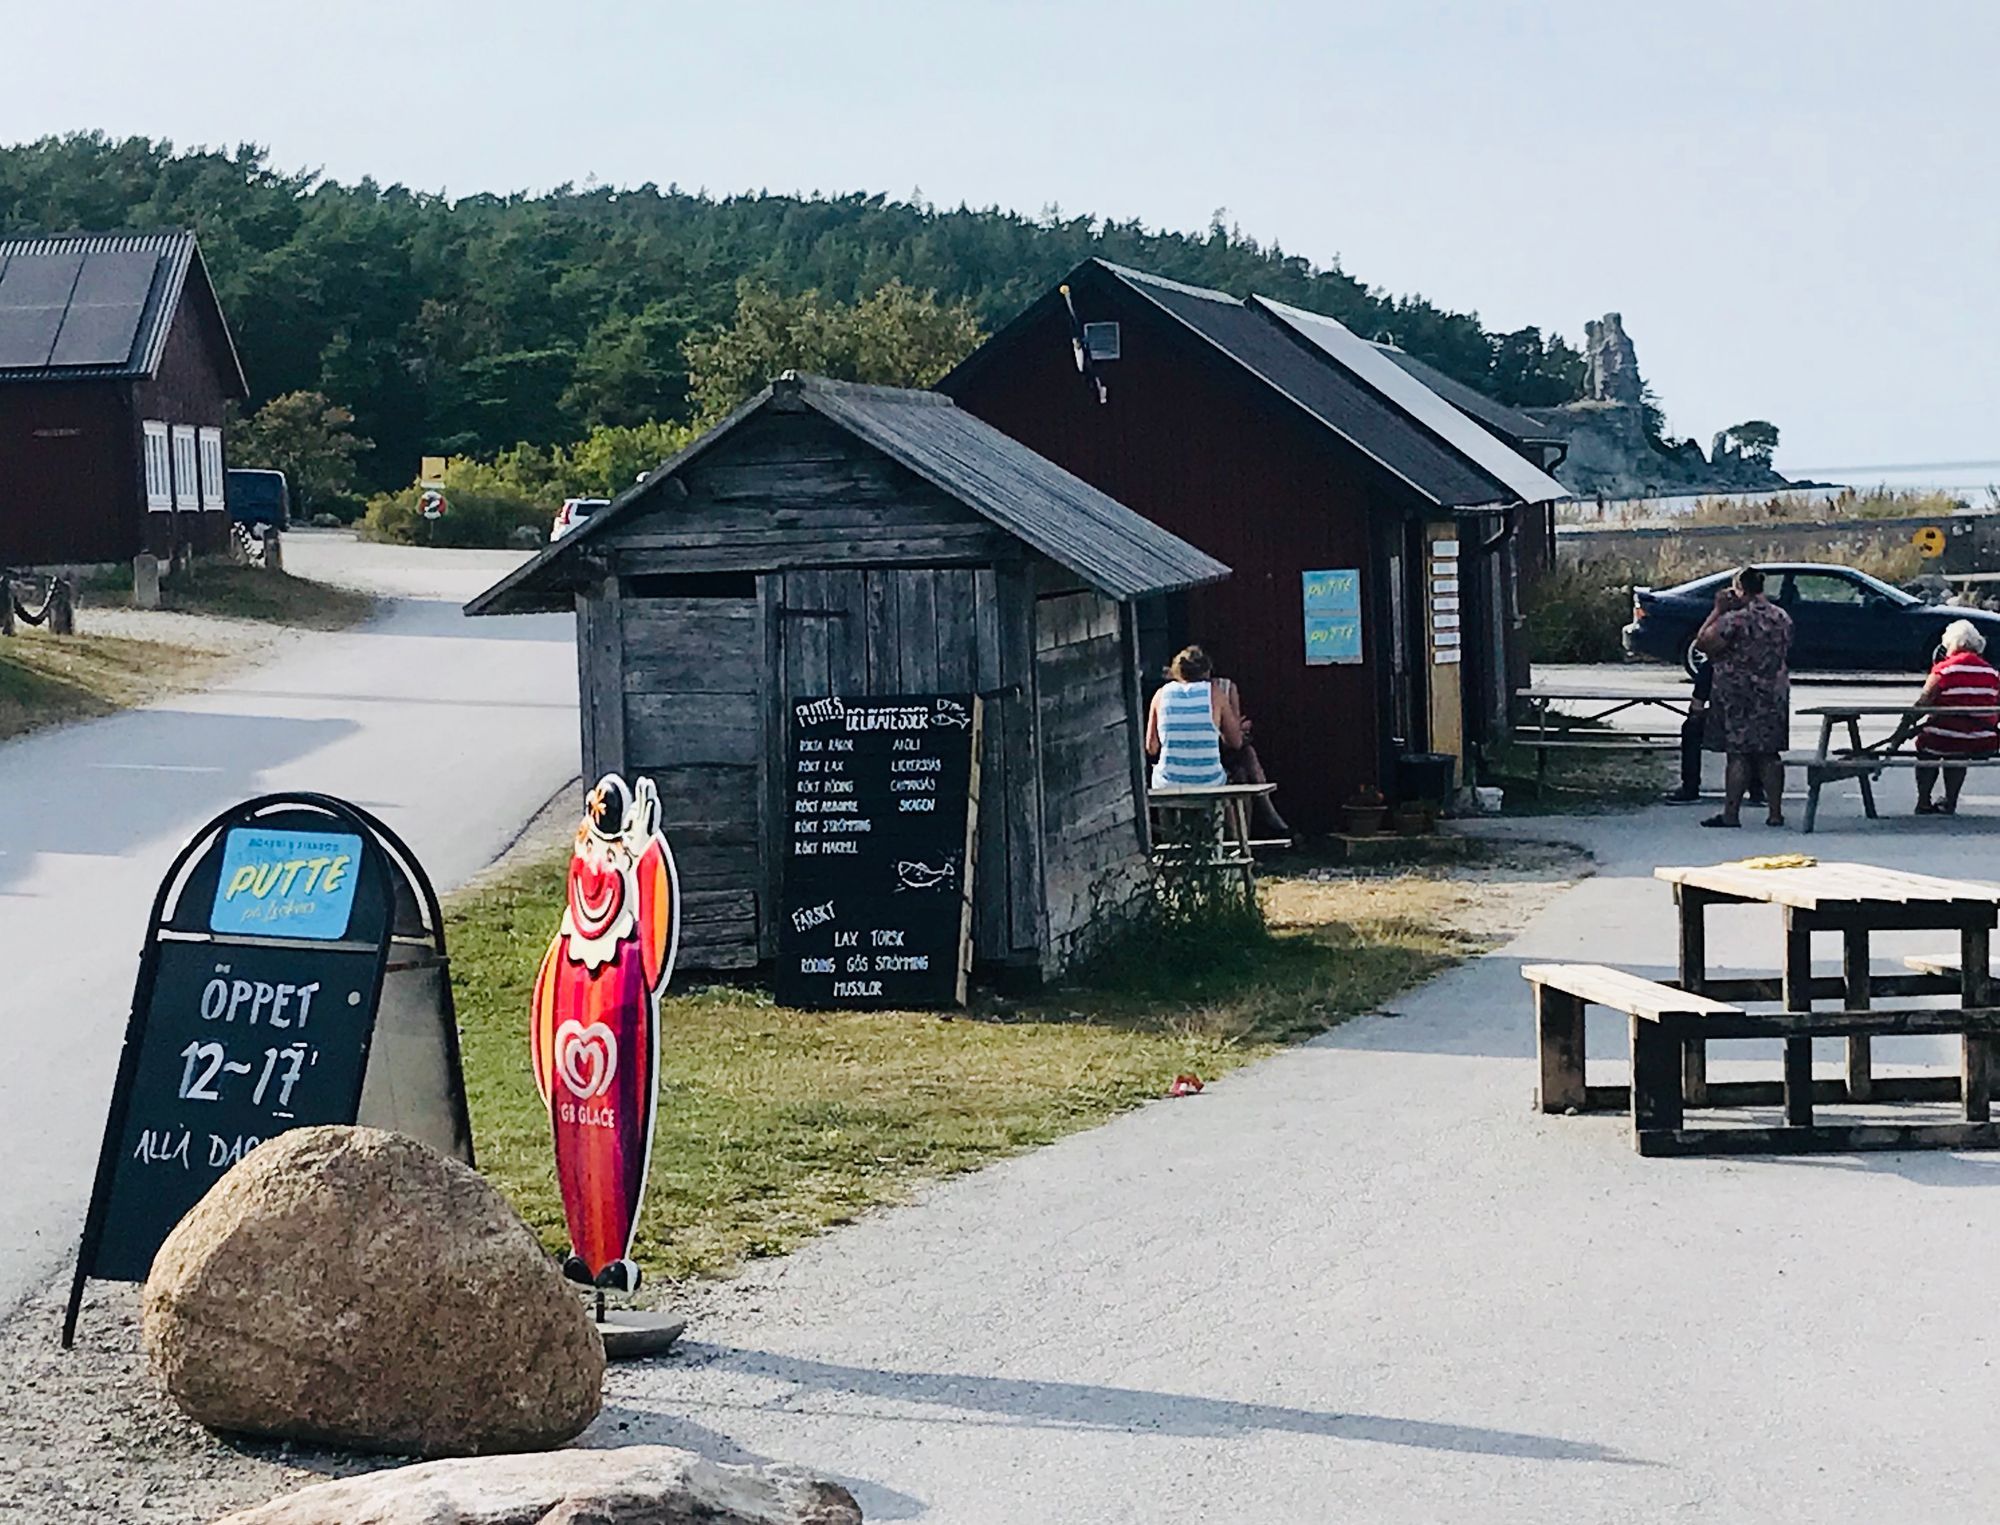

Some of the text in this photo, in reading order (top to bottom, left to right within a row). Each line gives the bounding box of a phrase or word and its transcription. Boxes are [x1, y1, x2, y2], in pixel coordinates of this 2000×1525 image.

[796, 696, 845, 728] PUTTES
[797, 759, 844, 773] RÖKT LAX
[797, 779, 821, 793] RÖKT
[795, 798, 819, 813] RÖKT
[794, 818, 819, 834] RÖKT
[794, 840, 819, 855] RÖKT
[224, 854, 352, 902] PUTTE
[791, 900, 836, 932] FÄRSKT
[834, 929, 905, 947] LAX TORSK
[846, 953, 869, 972] GÖS
[201, 963, 320, 1028] ÖPPET
[833, 981, 883, 997] MUSSLOR
[561, 1102, 615, 1129] GB GLACE
